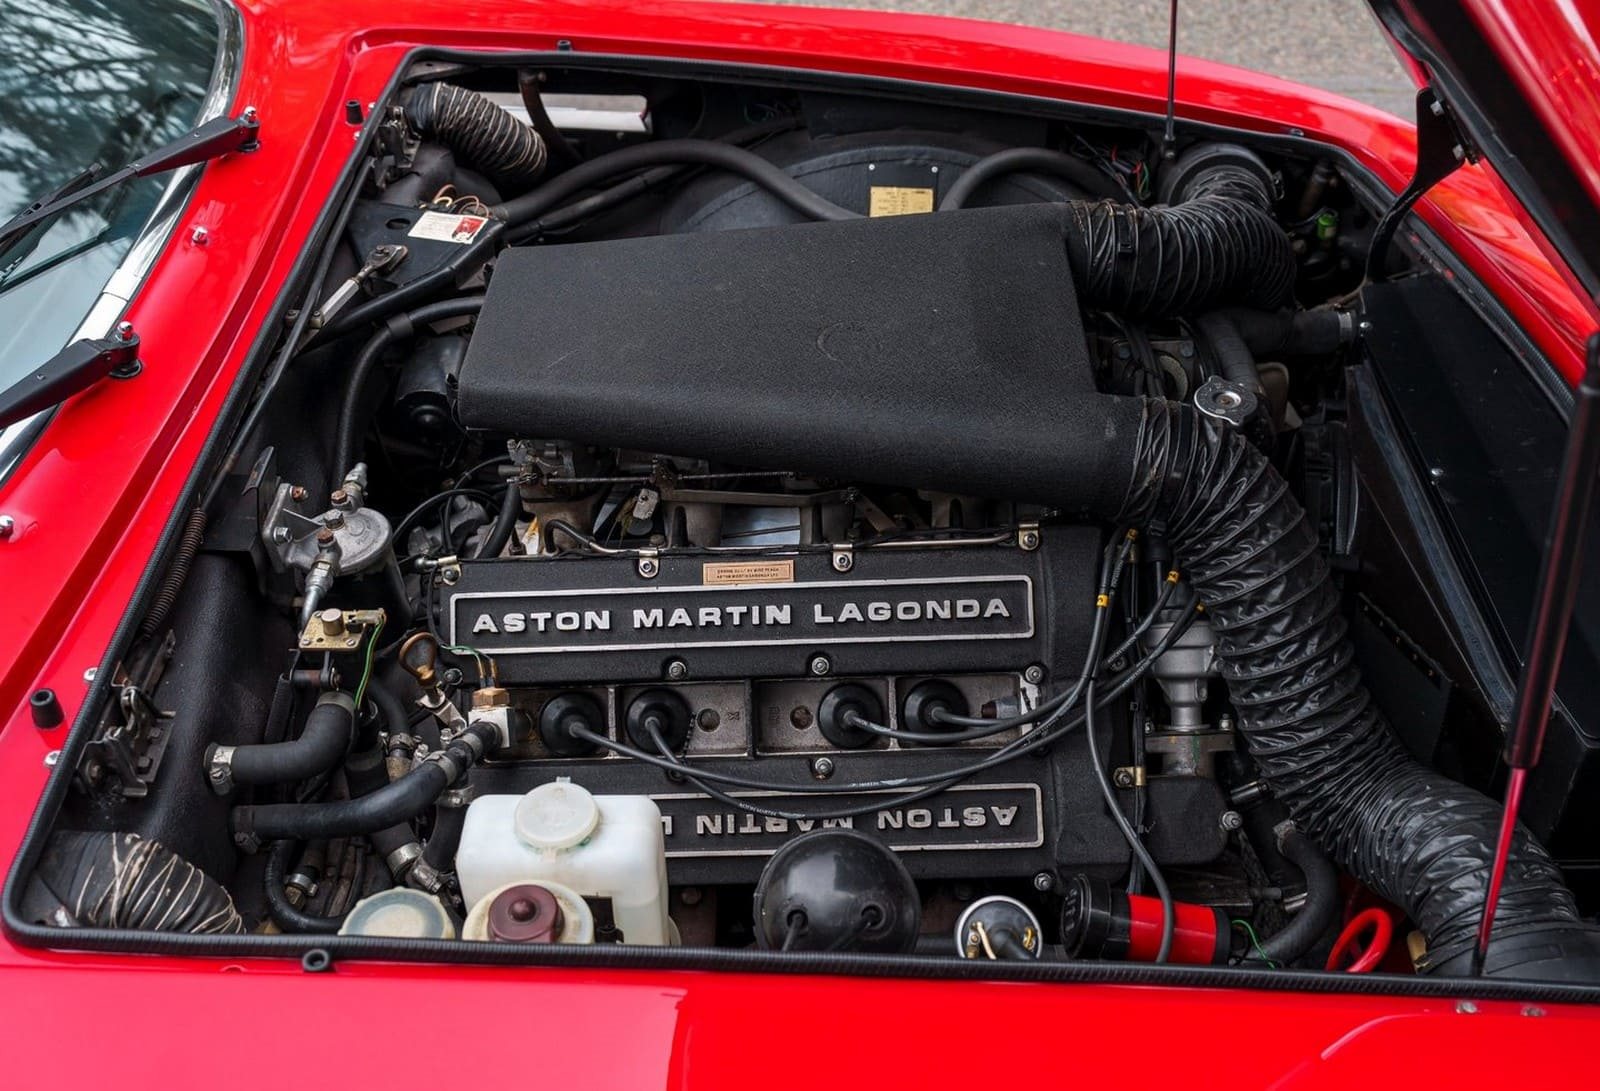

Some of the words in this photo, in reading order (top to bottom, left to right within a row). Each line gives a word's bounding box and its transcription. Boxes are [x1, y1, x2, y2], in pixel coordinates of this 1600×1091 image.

[472, 610, 610, 633] ASTON
[633, 605, 791, 629] MARTIN
[814, 598, 1010, 624] LAGONDA
[877, 806, 1018, 830] ASTON
